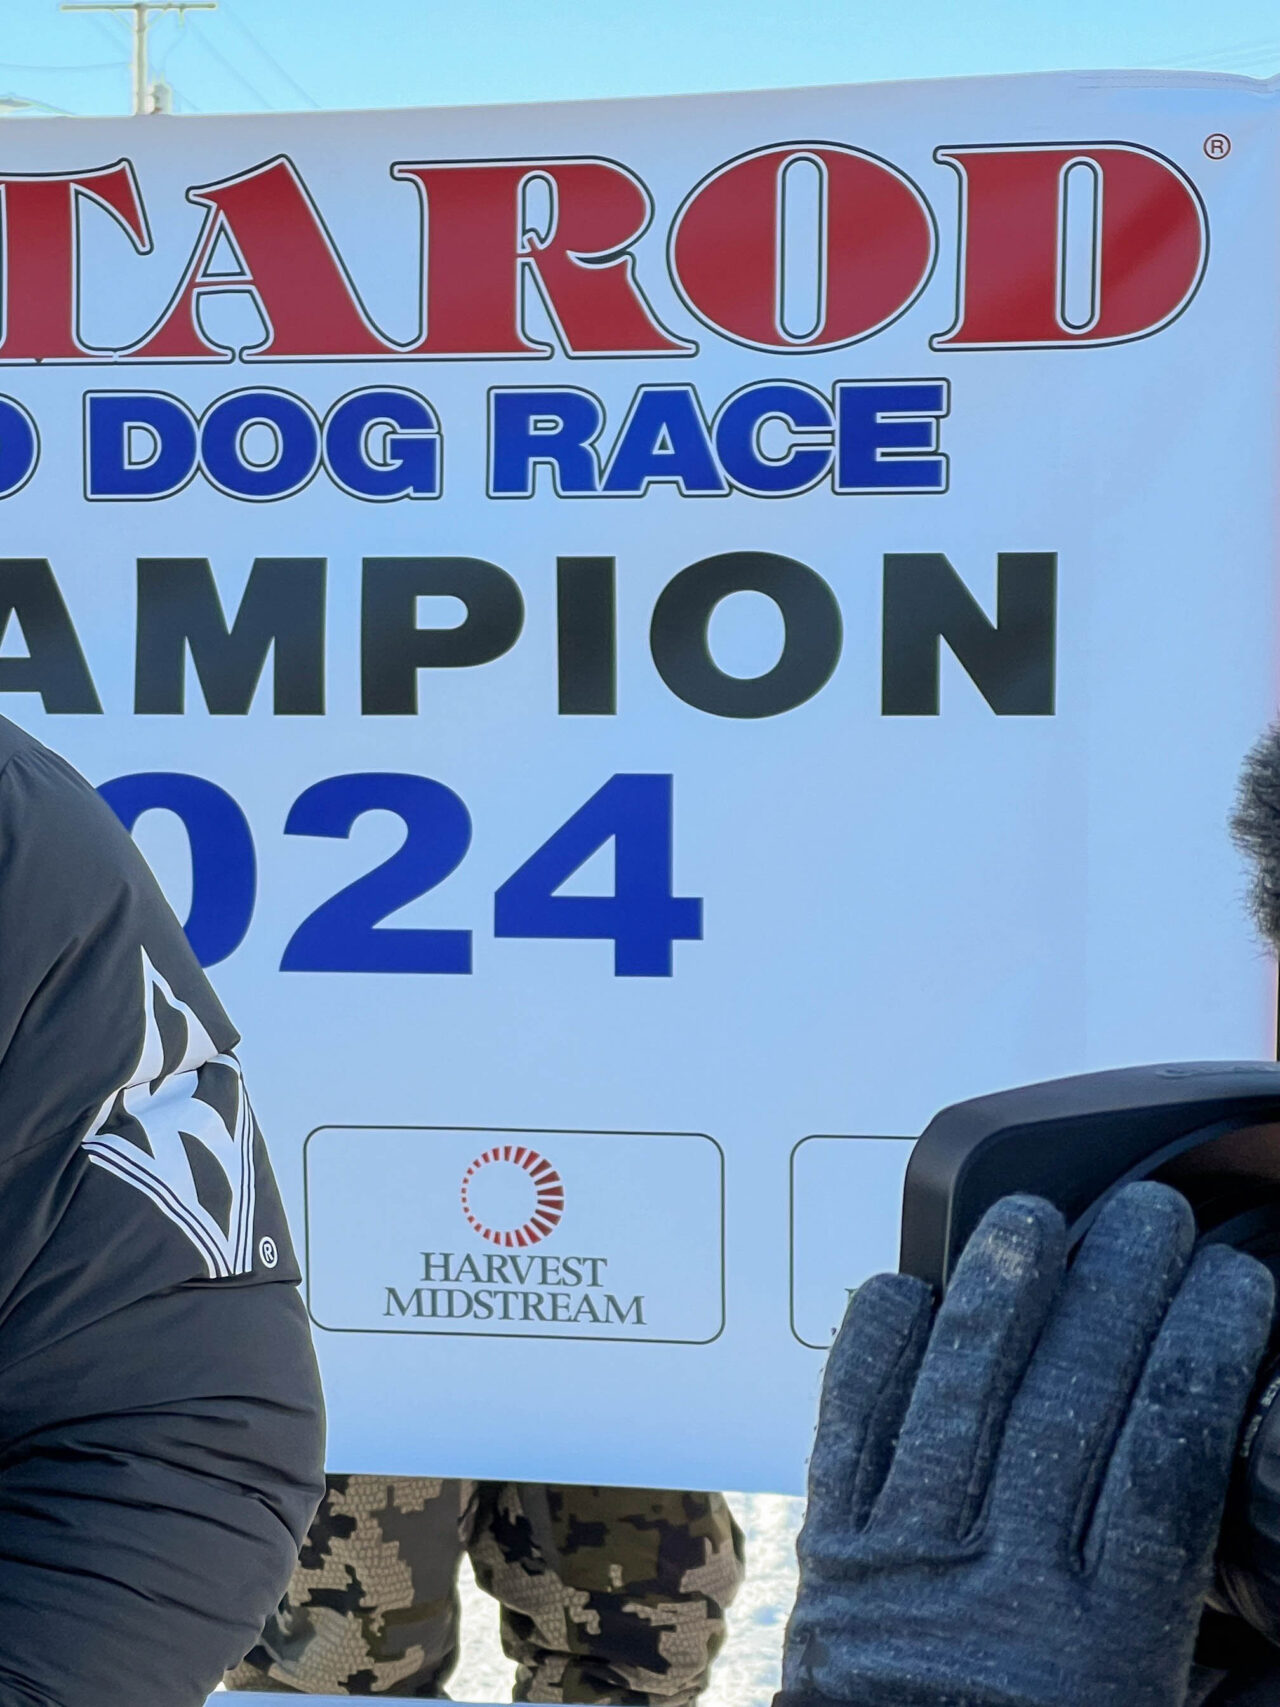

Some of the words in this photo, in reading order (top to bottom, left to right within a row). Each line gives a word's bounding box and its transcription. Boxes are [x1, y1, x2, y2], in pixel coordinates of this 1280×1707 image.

[83, 385, 443, 502] DOG
[486, 378, 951, 500] RACE
[96, 771, 705, 978] 024
[382, 1286, 648, 1325] MIDSTREAM
[419, 1251, 608, 1288] HARVEST
